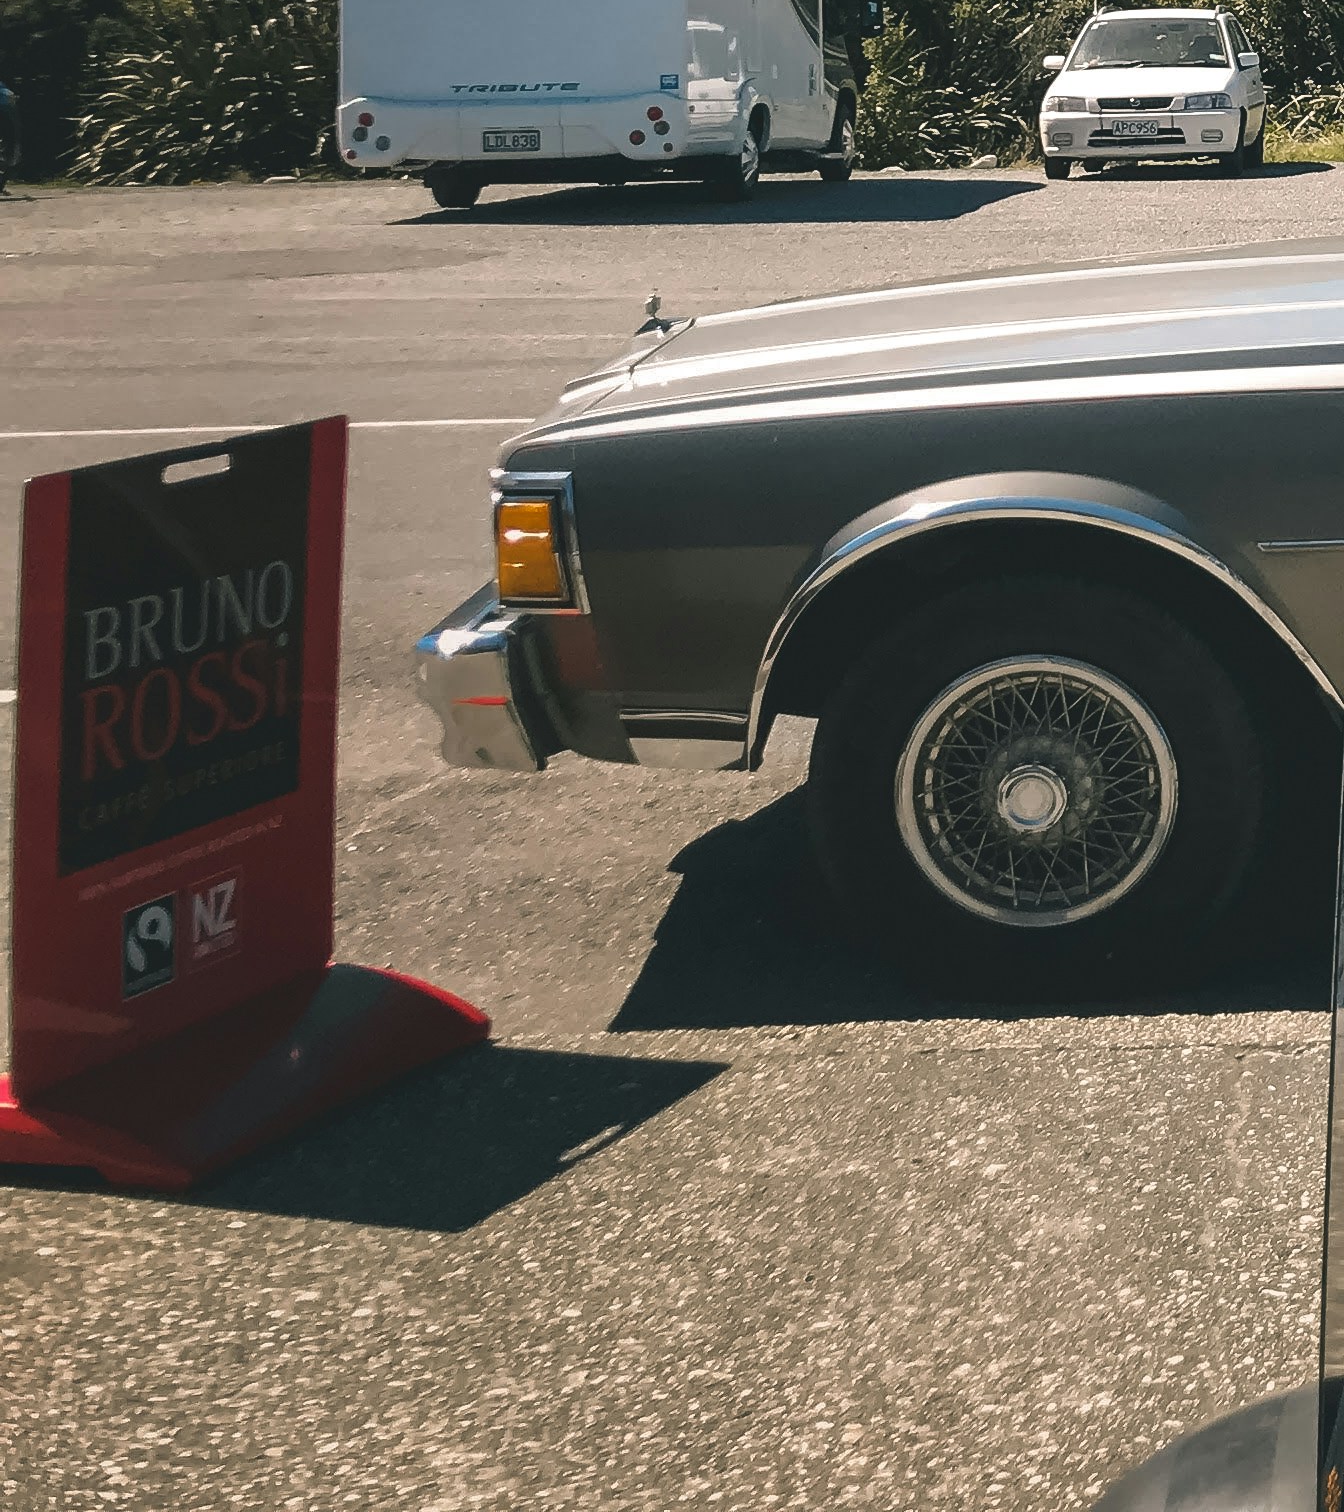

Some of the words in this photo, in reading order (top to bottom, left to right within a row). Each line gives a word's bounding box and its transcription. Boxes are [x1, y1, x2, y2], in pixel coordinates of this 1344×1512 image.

[450, 82, 580, 93] TRIBUTE
[1115, 122, 1157, 134] APC956
[82, 559, 294, 681] BRUNO
[191, 877, 238, 944] NZ
